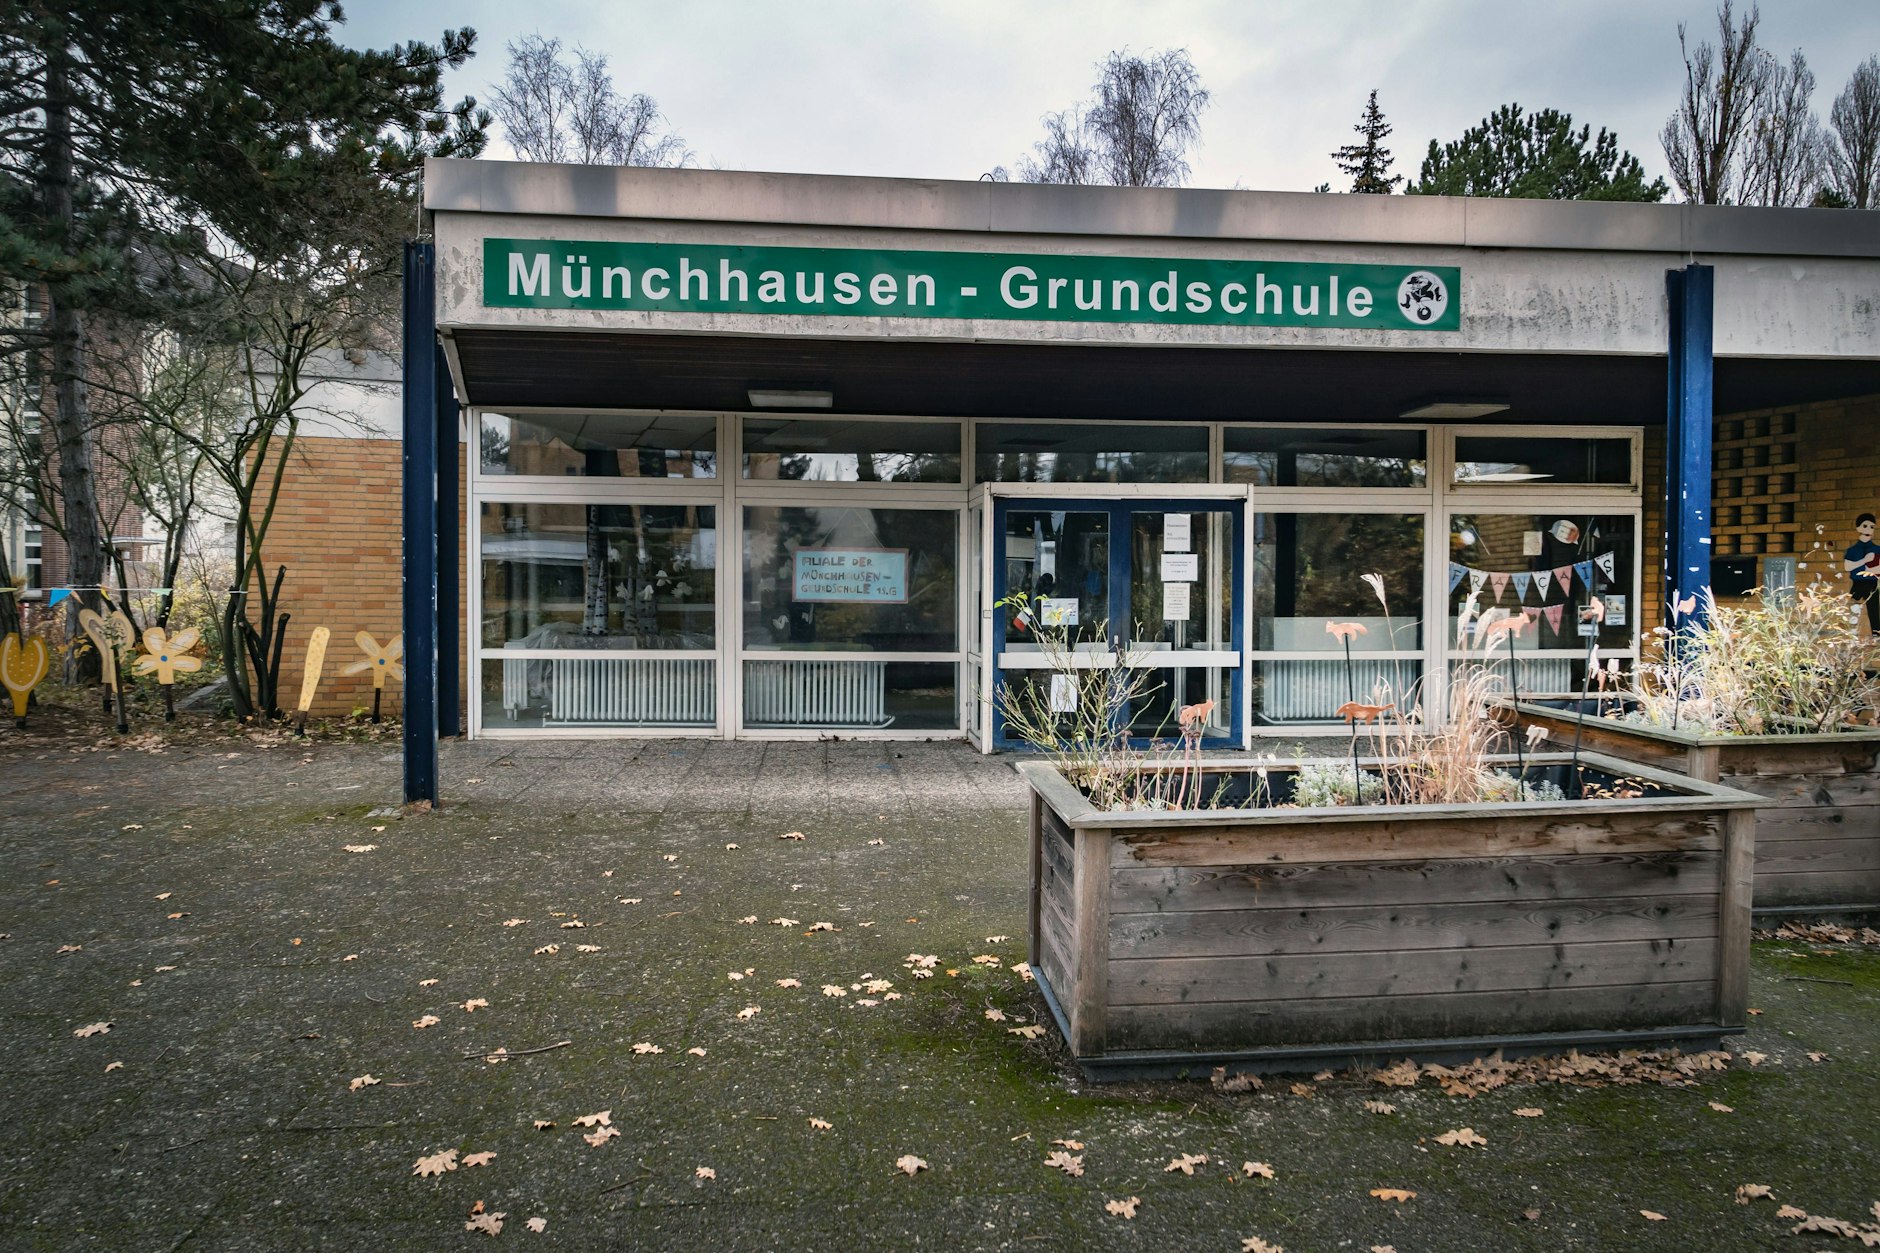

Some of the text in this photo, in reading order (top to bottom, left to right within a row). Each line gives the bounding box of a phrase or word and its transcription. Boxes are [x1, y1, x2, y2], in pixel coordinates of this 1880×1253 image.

[508, 252, 1374, 317] Münchhausen - Grundschule
[852, 557, 873, 567] DER
